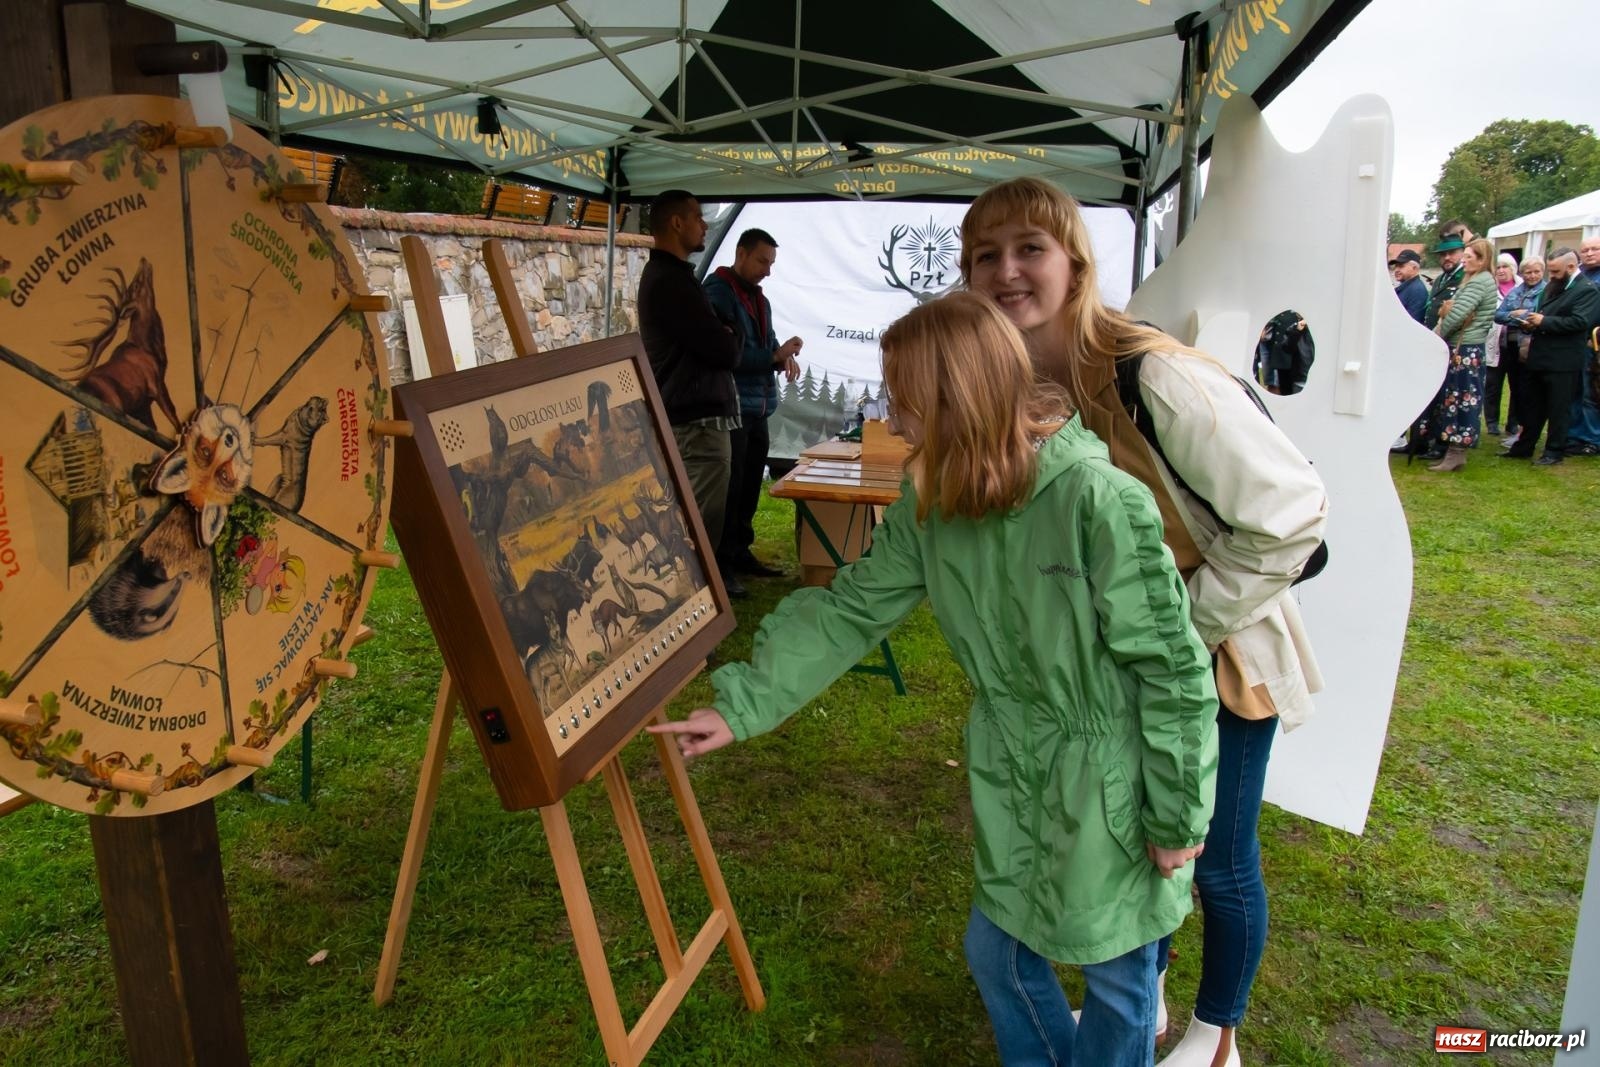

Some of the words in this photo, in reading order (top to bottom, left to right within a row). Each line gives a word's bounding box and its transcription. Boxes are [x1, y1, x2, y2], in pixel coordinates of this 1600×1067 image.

[10, 246, 60, 308] GRUBA
[56, 193, 148, 248] ZWIERZYNA
[229, 219, 303, 295] ŚRODOWISKA
[243, 211, 299, 267] OCHRONA
[57, 232, 115, 285] ŁOWNA
[910, 271, 947, 289] PZŁ
[826, 325, 874, 344] Zarząd
[346, 389, 360, 475] ZWIERZĘTA
[509, 404, 559, 432] ODGŁOSY
[560, 396, 583, 416] LASU
[336, 388, 350, 482] CHRONIONE
[303, 600, 314, 615] W
[321, 574, 336, 604] JAK
[273, 604, 324, 679] ZACHOWAĆ
[278, 615, 304, 652] LESIE
[109, 685, 163, 713] ŁOWNA
[255, 671, 274, 694] SIĘ
[61, 680, 146, 731] ZWIERZYNA
[149, 711, 207, 732] DROBNA
